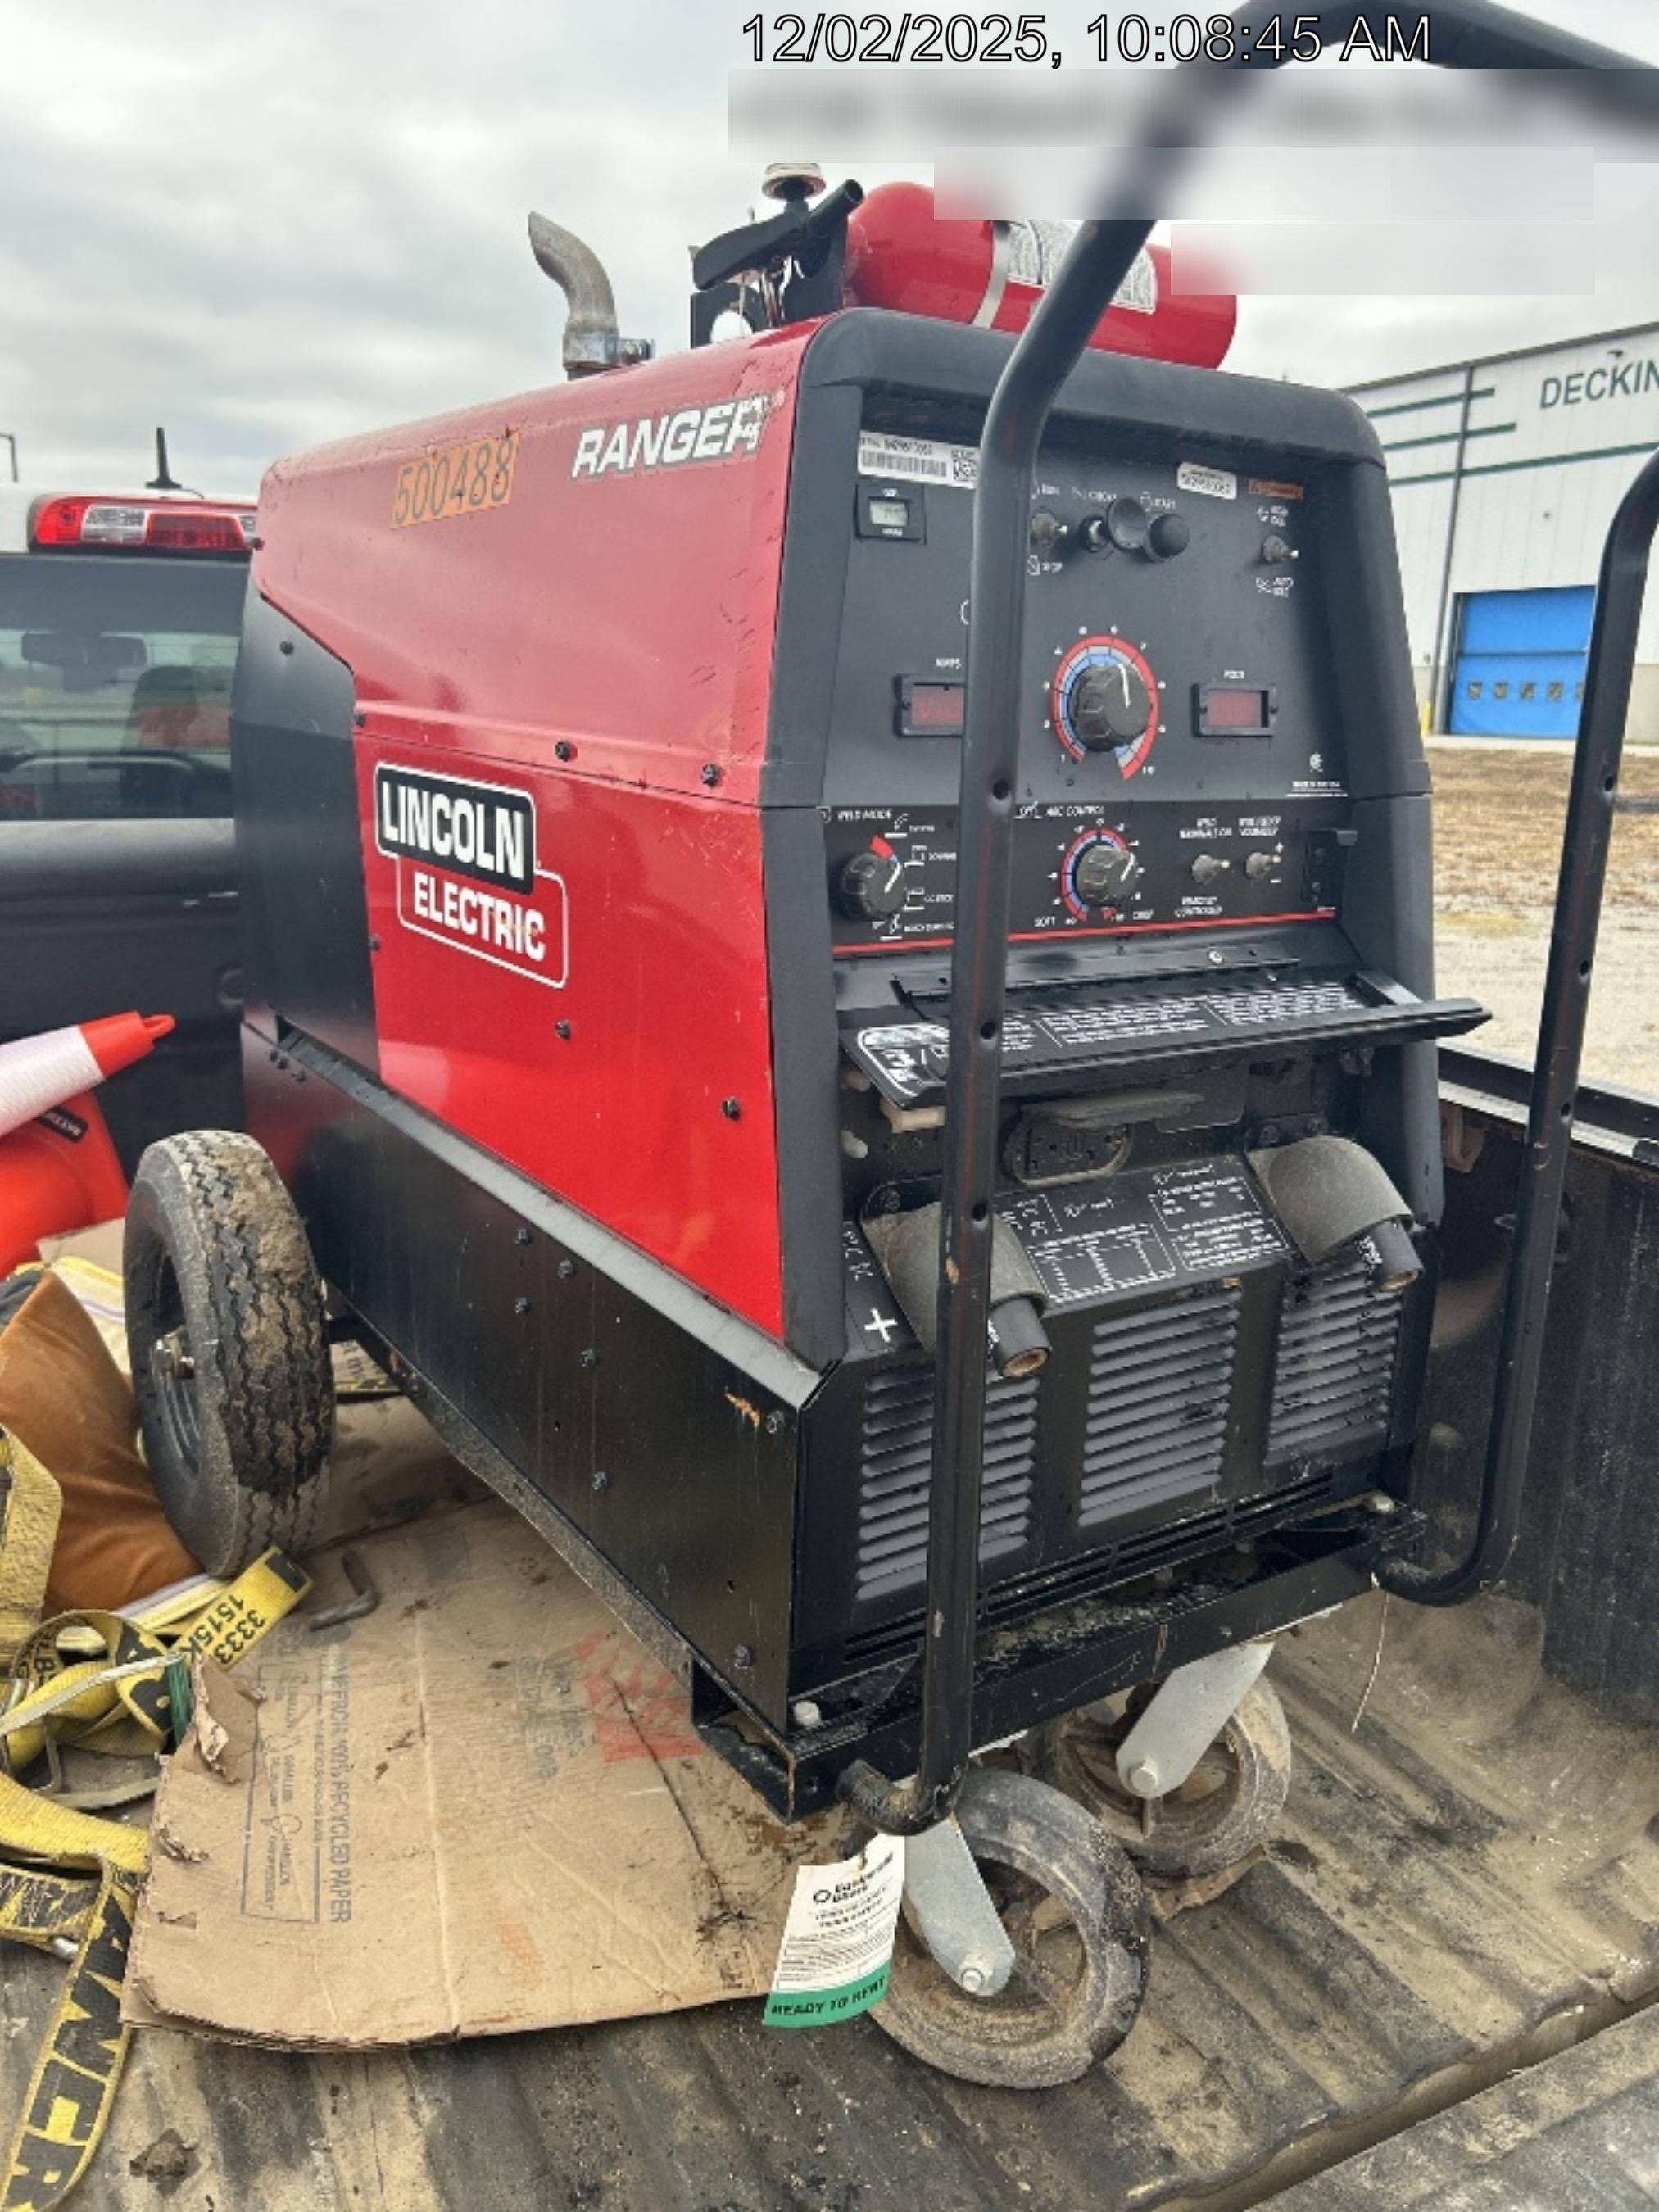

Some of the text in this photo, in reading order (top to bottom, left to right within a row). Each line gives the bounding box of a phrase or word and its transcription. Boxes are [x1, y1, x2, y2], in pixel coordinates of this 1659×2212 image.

[571, 397, 764, 479] RANGER
[394, 439, 514, 526] 500488
[382, 781, 524, 881] LINCOLN
[414, 871, 546, 962] ELECTRIC
[215, 1609, 265, 1665] 3333
[330, 1780, 351, 1865] RECYCLED
[330, 1867, 352, 1923] PAPER
